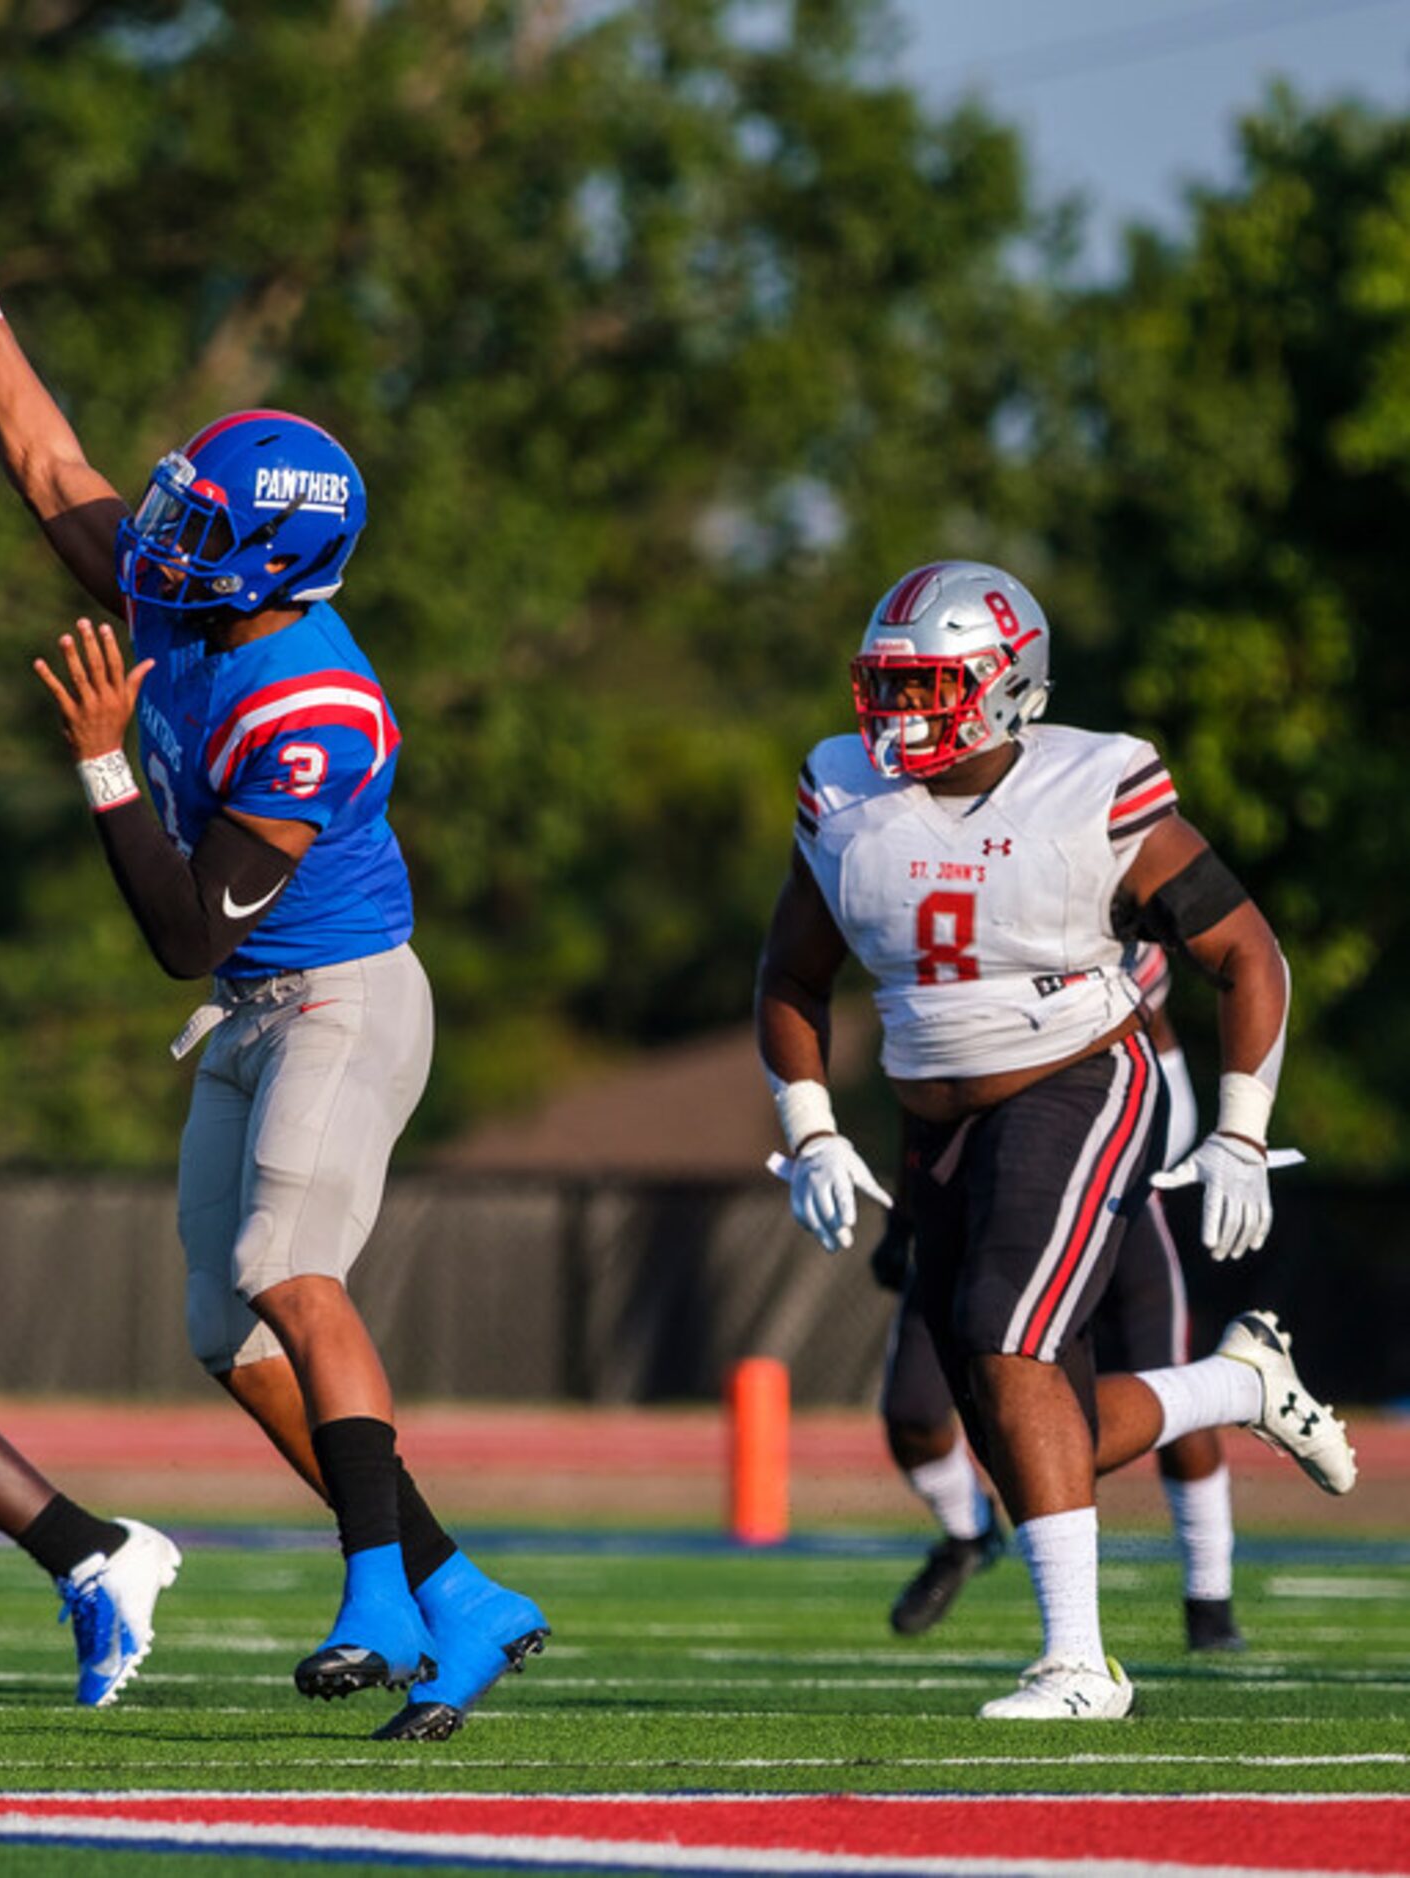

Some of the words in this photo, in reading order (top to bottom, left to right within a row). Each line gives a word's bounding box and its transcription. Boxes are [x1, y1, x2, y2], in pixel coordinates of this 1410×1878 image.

[254, 467, 350, 504] PANTHERS
[983, 590, 1021, 639] 8
[271, 742, 330, 800] 3
[910, 861, 930, 880] ST.
[936, 862, 987, 884] JOHN'S
[915, 890, 981, 987] 8
